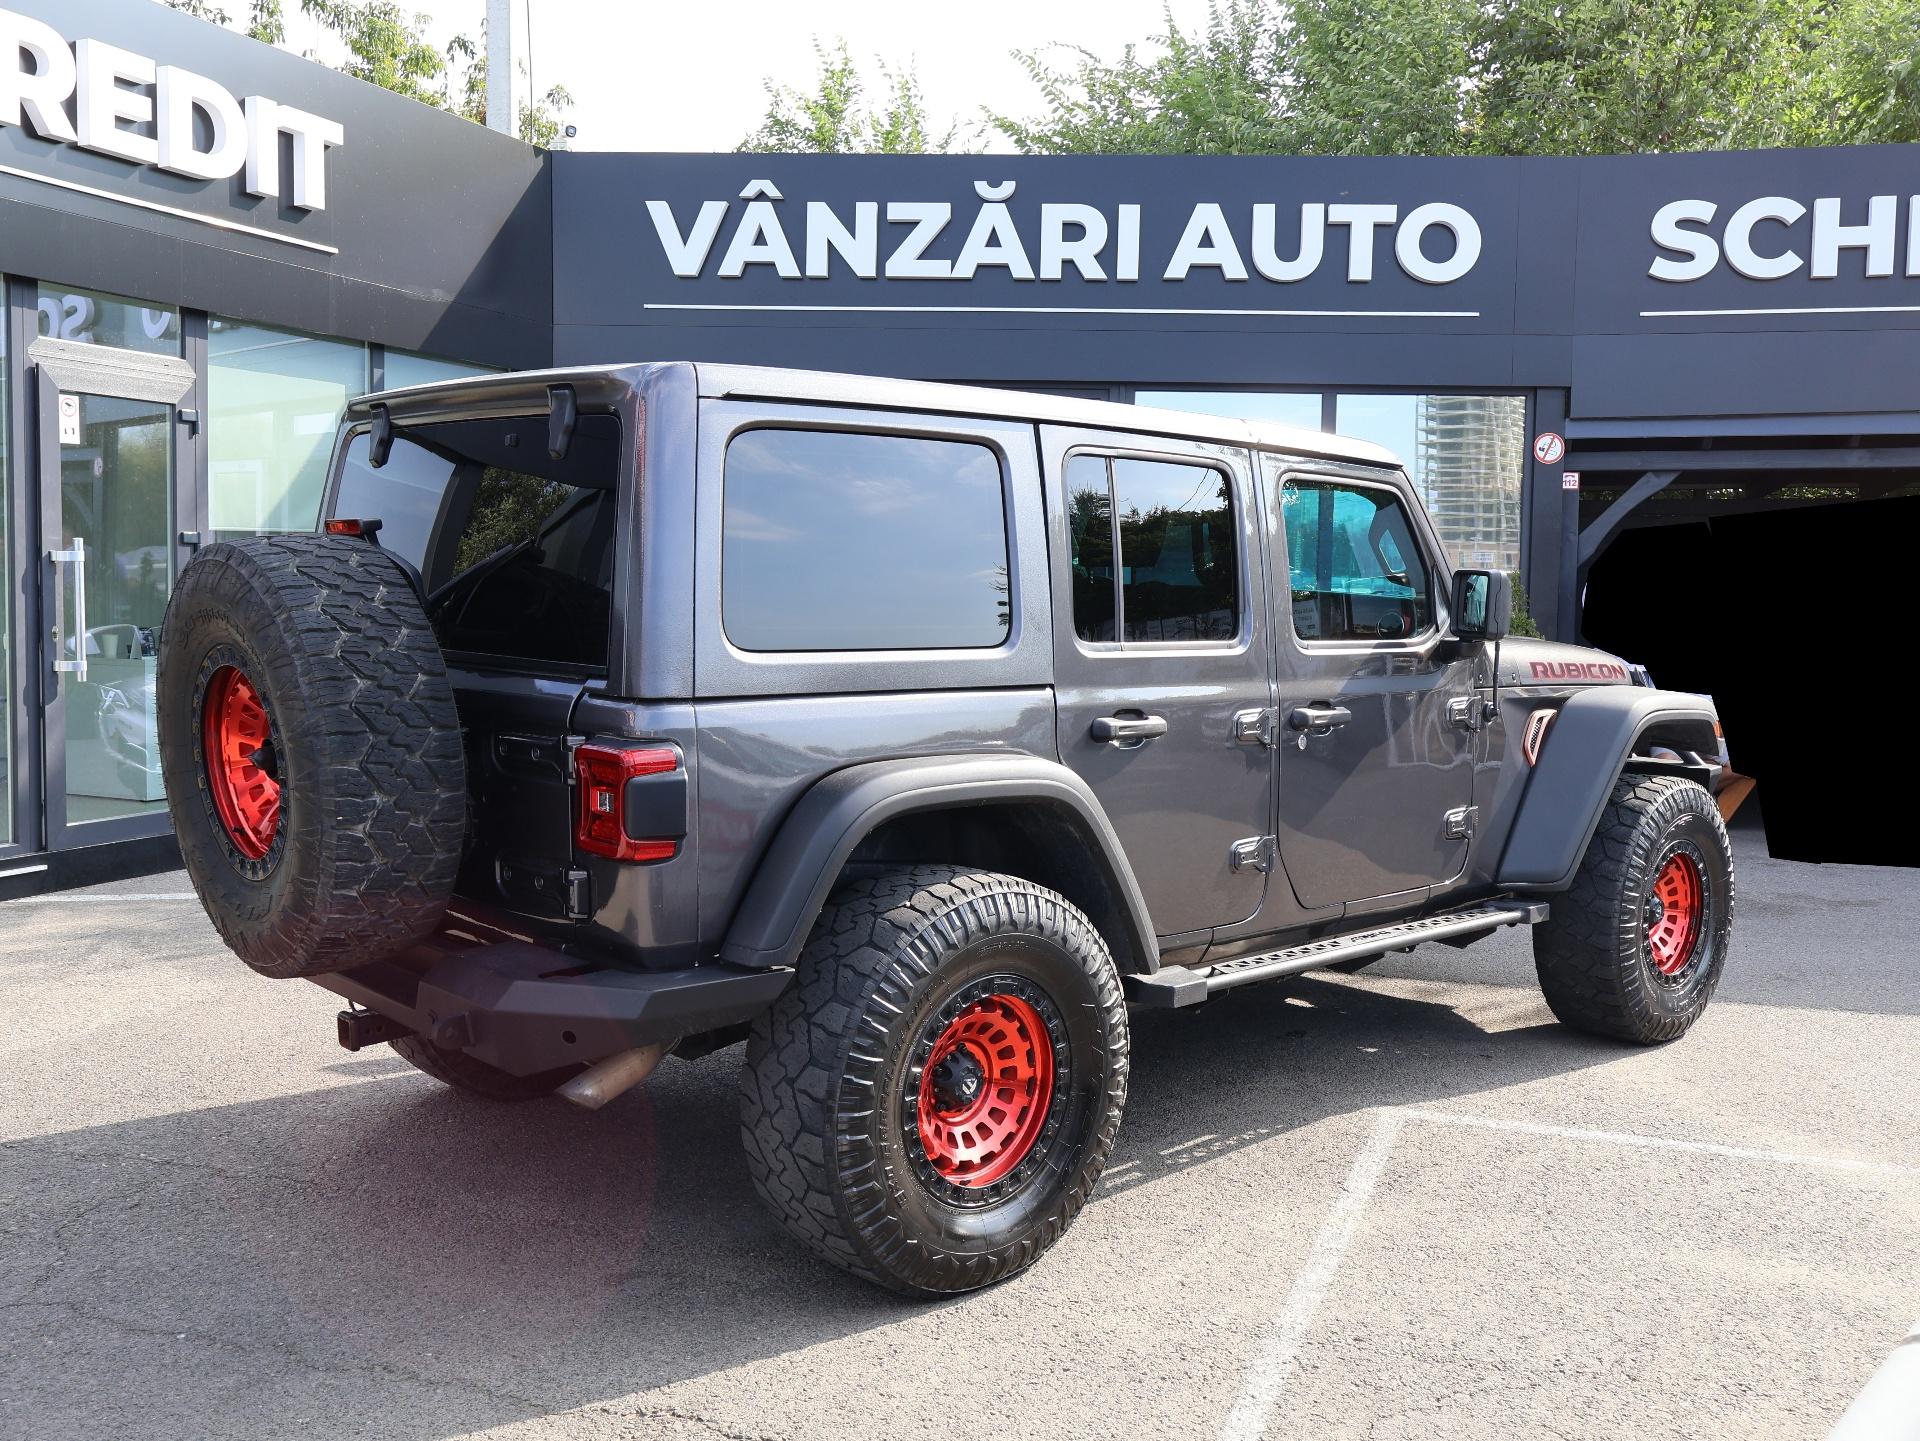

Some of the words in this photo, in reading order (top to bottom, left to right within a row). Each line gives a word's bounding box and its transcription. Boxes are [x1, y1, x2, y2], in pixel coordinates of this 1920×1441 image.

[644, 179, 1141, 282] VÂNZĂRI
[1162, 201, 1482, 284] AUTO
[1529, 662, 1627, 679] RUBICON
